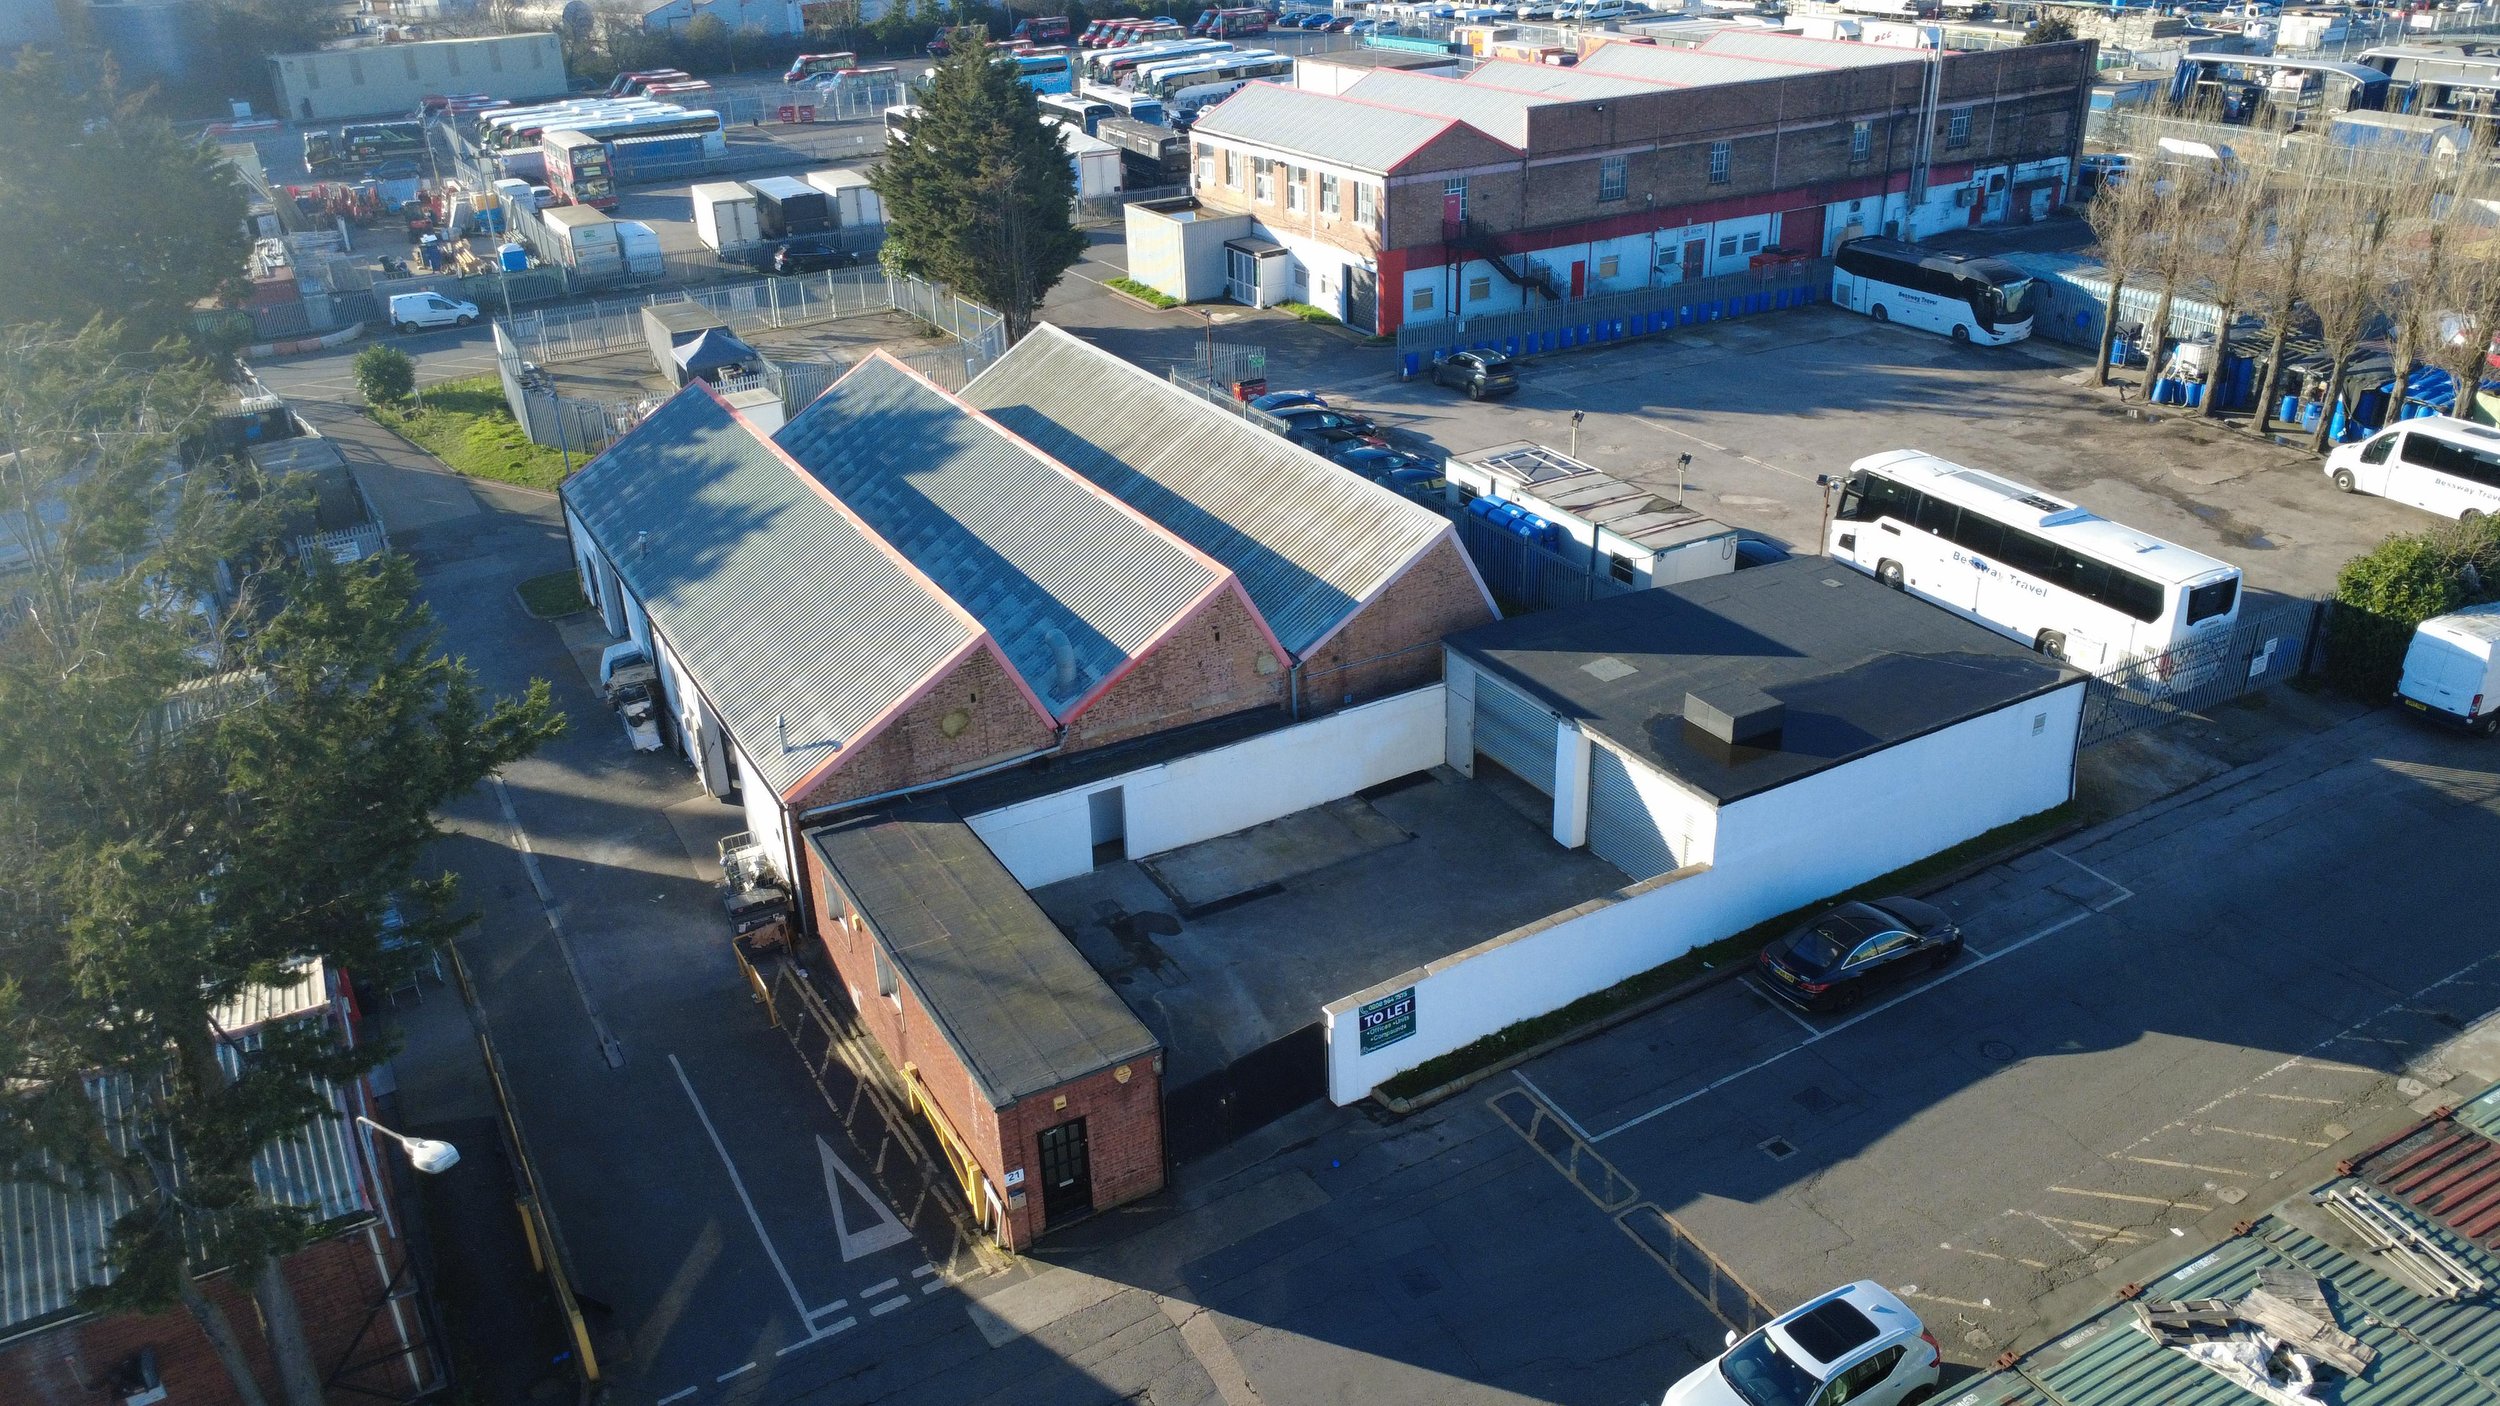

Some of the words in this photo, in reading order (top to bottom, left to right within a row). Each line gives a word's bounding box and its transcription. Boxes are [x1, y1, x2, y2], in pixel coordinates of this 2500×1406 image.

[2434, 477, 2475, 495] Bessway
[1952, 550, 2004, 582] Bessway
[2009, 573, 2048, 598] Travel
[1364, 1011, 1384, 1027] TO
[1387, 1000, 1411, 1019] LET
[1008, 1171, 1020, 1182] 21
